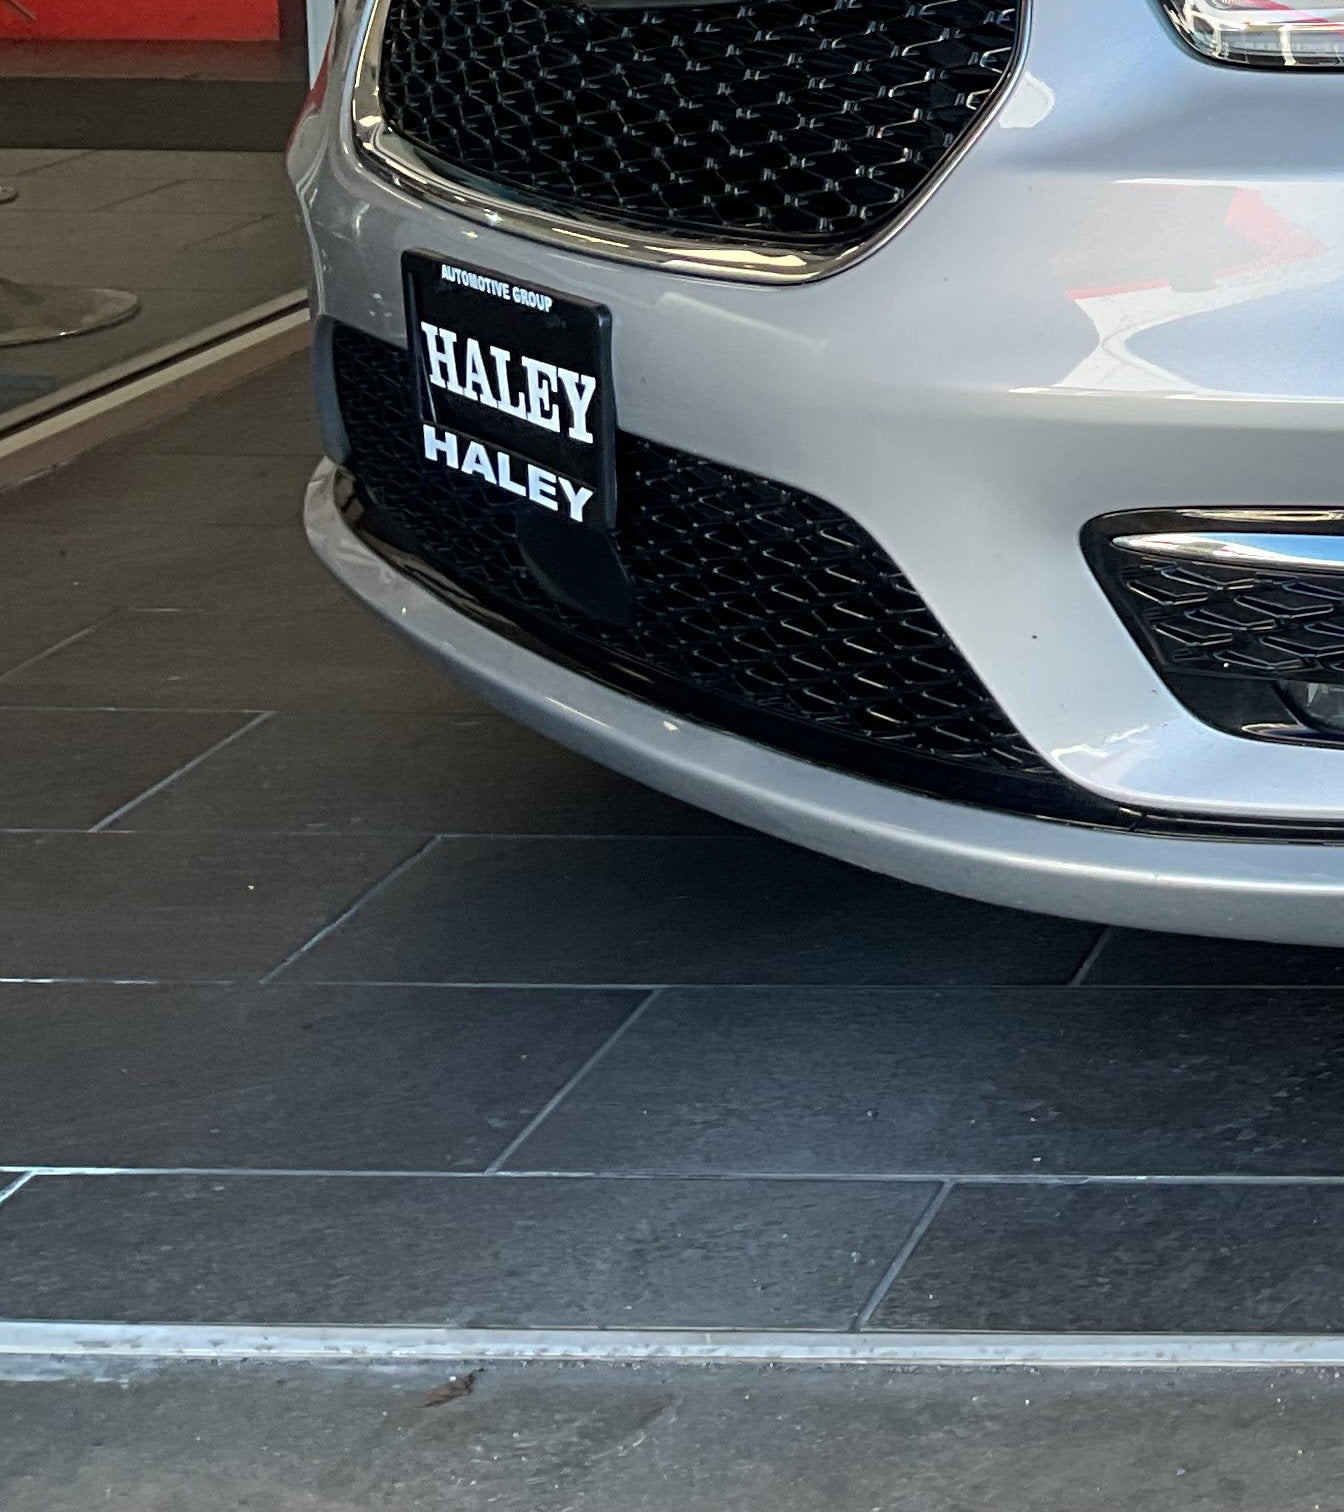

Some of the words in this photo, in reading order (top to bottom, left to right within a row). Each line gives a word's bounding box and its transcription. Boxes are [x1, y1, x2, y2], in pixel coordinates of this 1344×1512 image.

[441, 264, 510, 300] AUTOMOTIVE
[512, 286, 553, 312] GROUP
[421, 321, 596, 444] HALEY
[423, 424, 594, 523] HALEY
